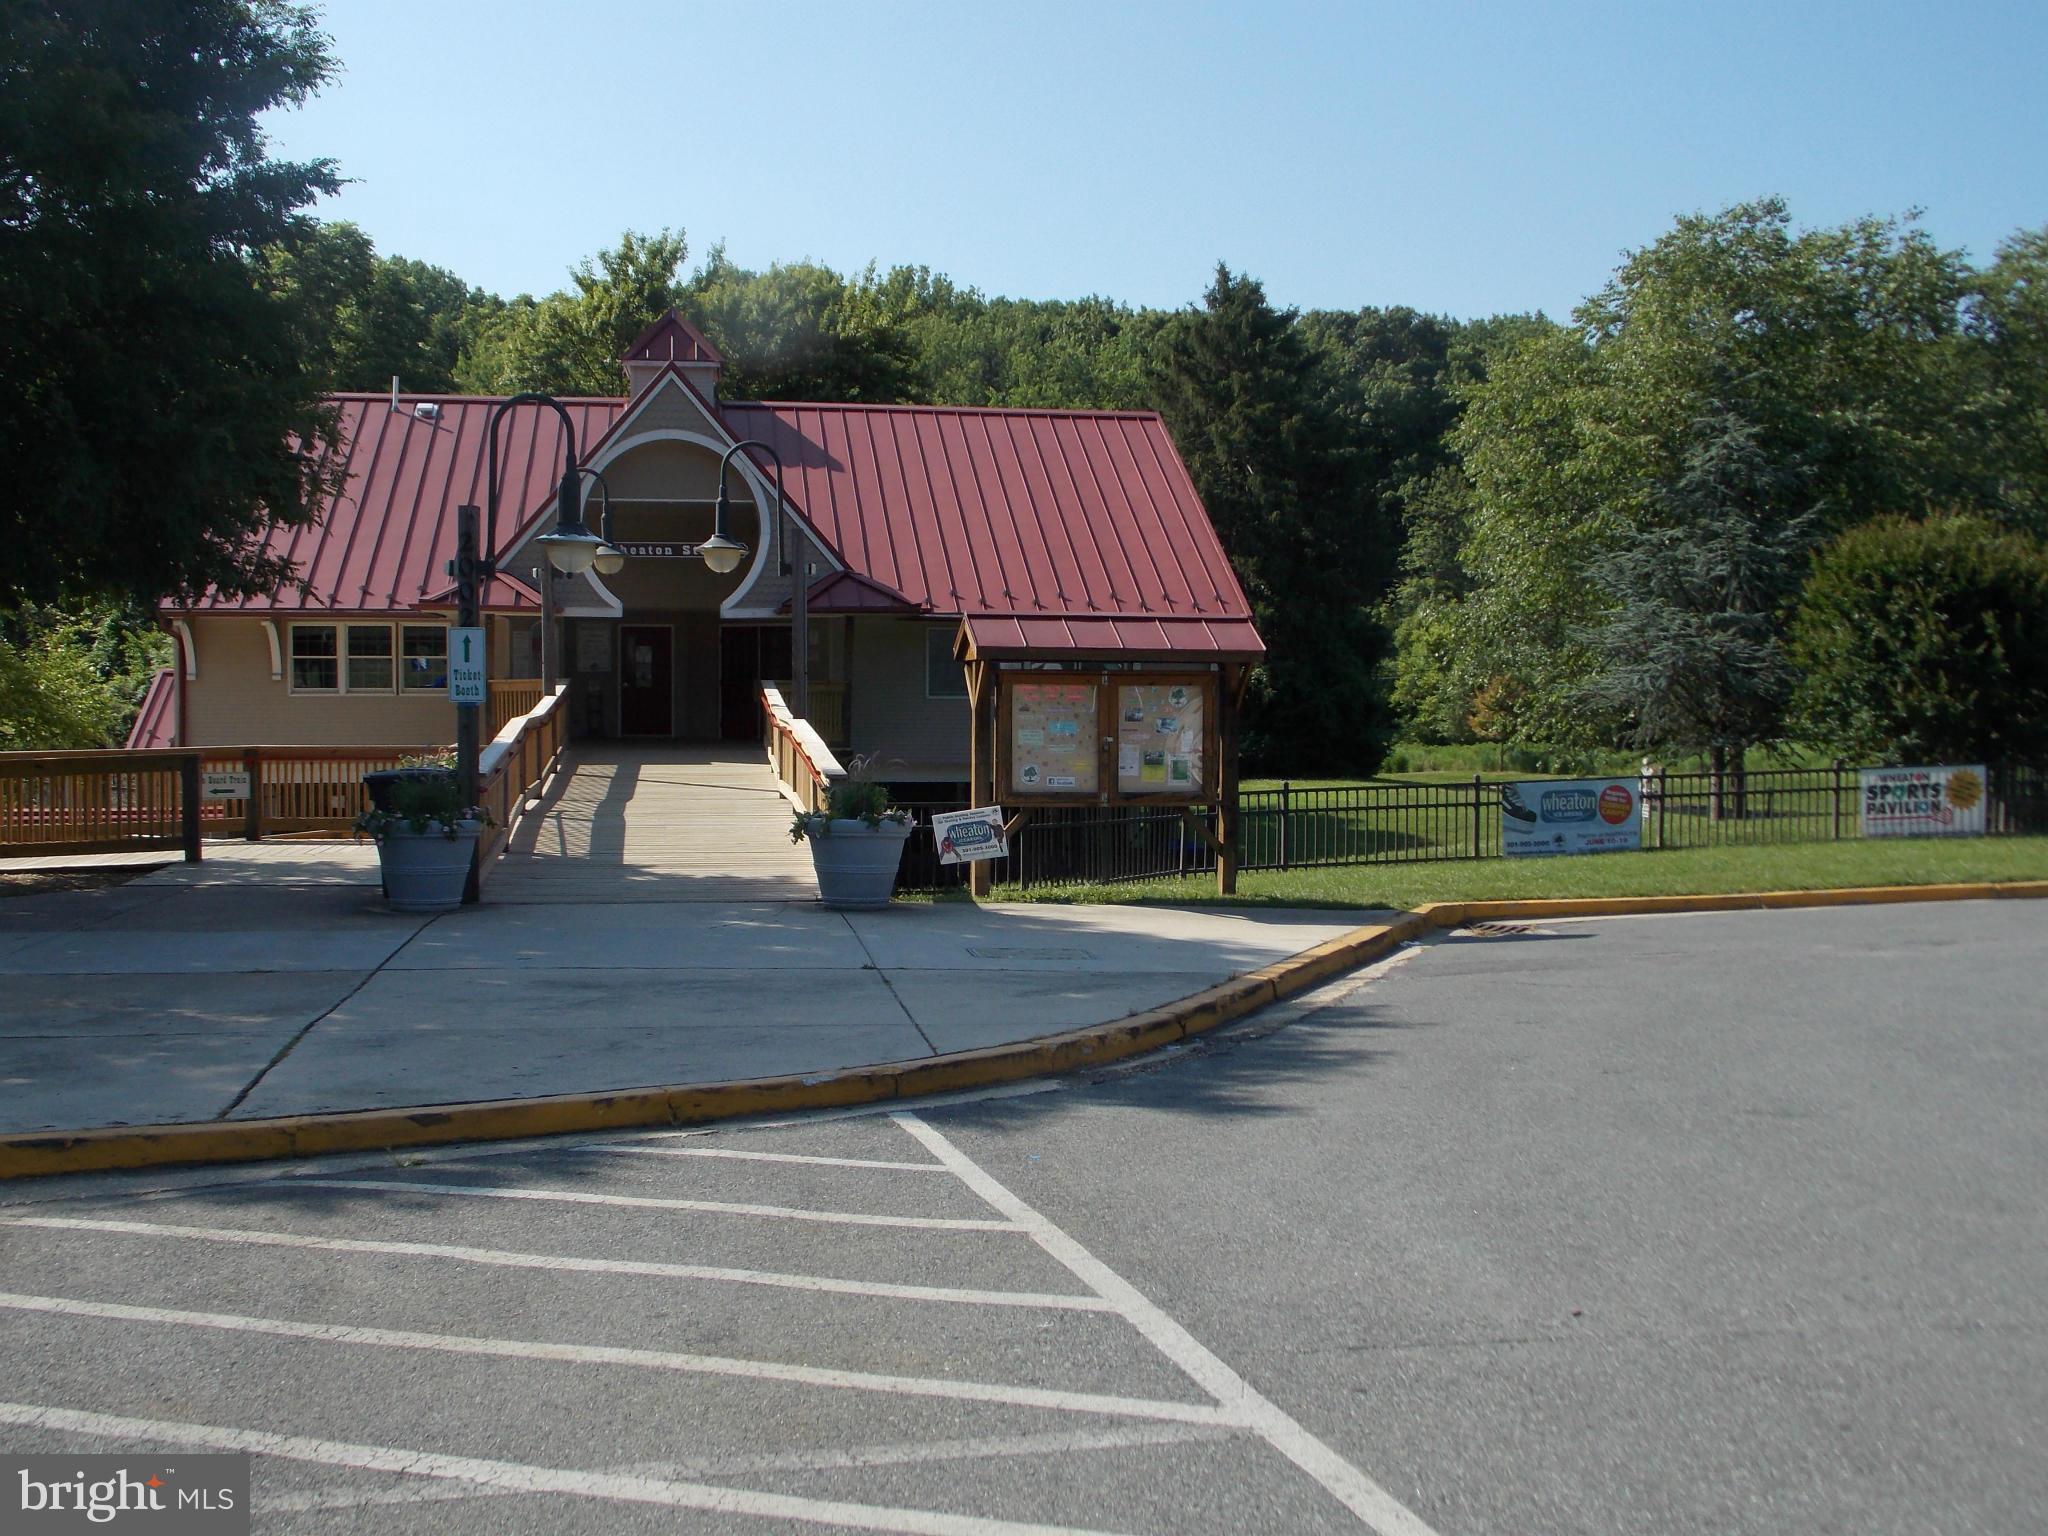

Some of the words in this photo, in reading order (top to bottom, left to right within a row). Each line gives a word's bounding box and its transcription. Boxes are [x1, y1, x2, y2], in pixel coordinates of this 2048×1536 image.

[617, 544, 673, 556] heaton
[453, 668, 481, 681] Ticket
[455, 684, 480, 697] Booth
[1866, 783, 1941, 801] SPORTS
[1542, 792, 1596, 811] wheaton
[1866, 801, 1943, 815] PAVILION
[949, 823, 990, 839] wheaton
